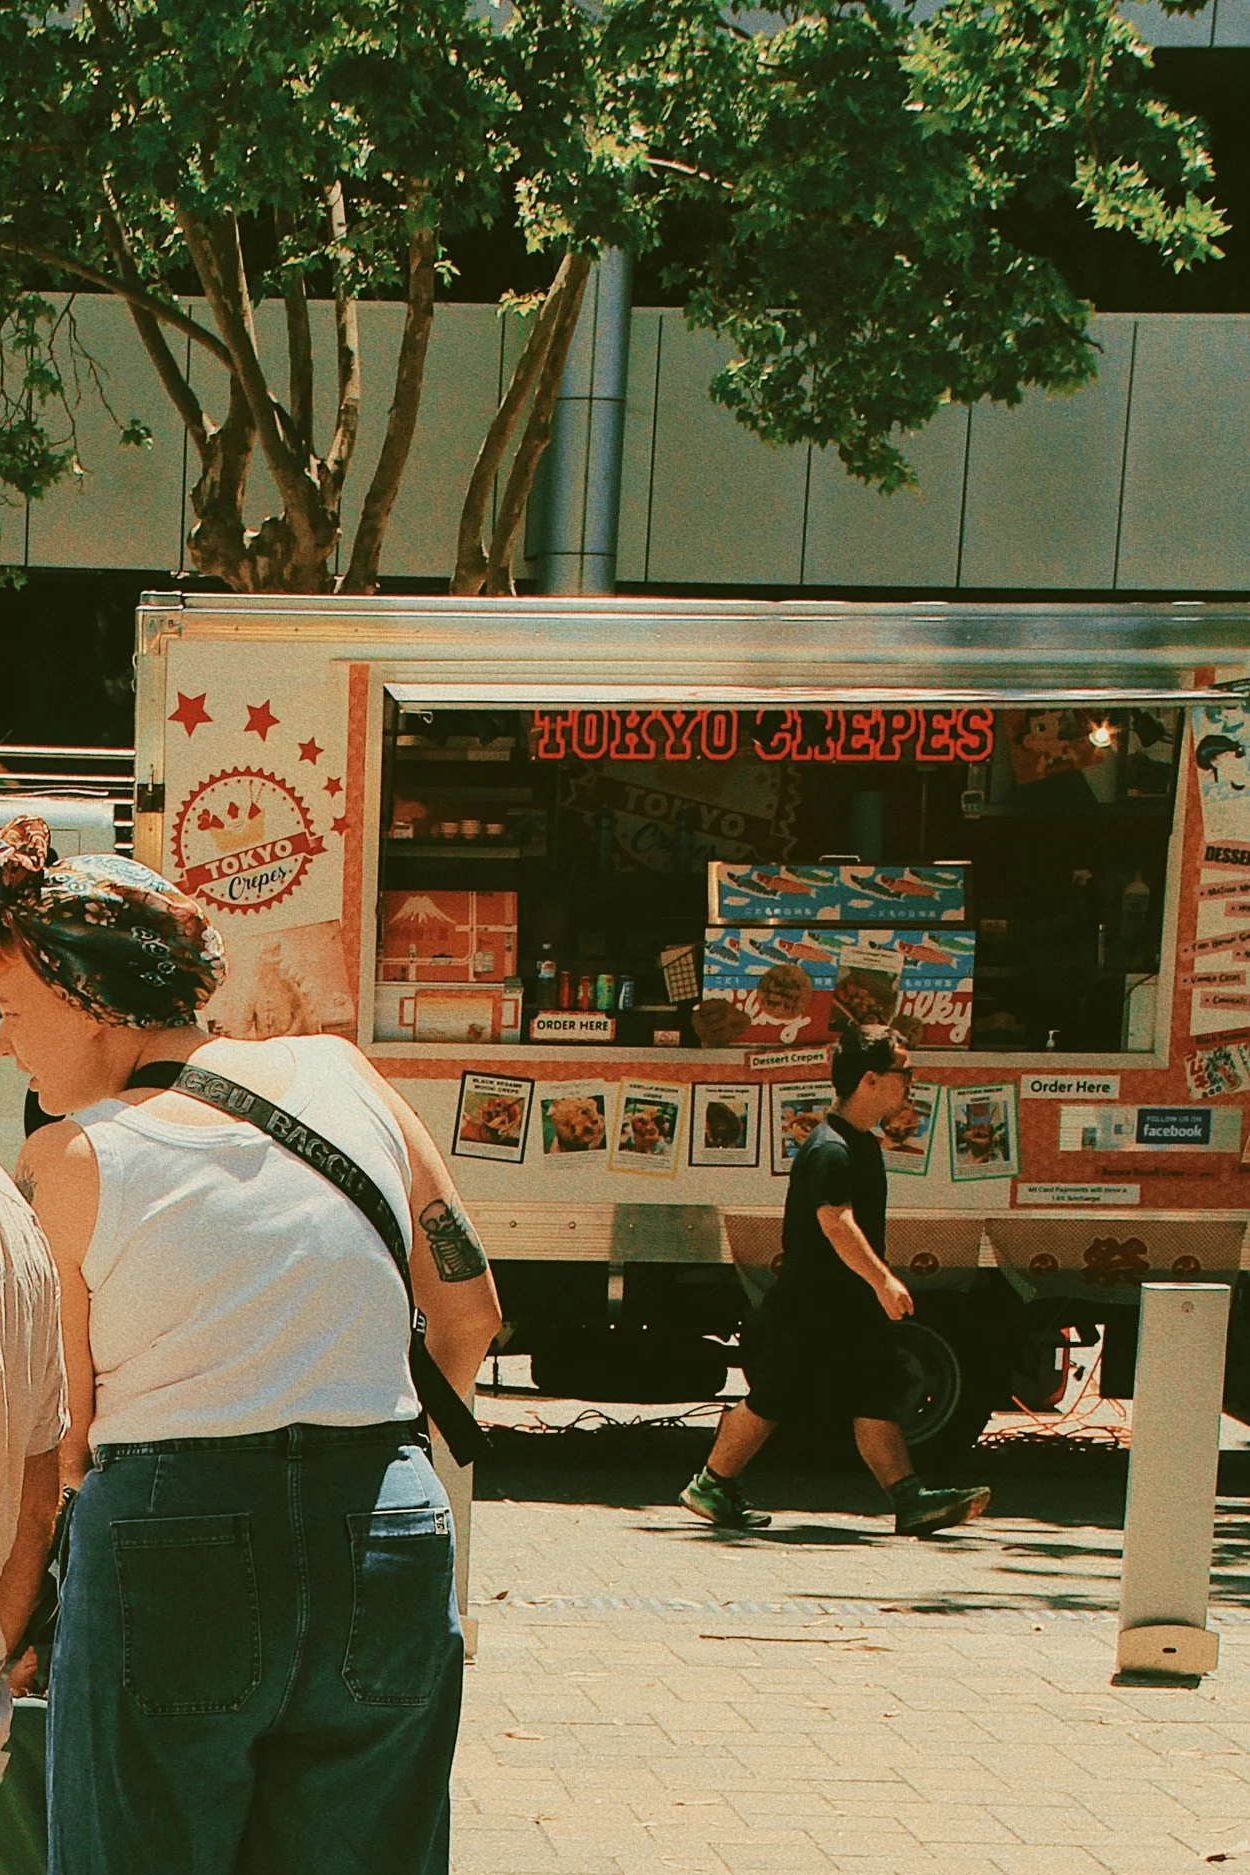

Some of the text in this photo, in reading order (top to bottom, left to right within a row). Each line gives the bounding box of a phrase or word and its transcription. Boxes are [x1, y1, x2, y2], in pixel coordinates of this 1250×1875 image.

[533, 709, 739, 760] TOKYO
[204, 839, 293, 879] TOKYO
[1204, 846, 1250, 866] DESSE
[228, 866, 288, 901] Crepes
[536, 1020, 610, 1031] ORDER HERE
[752, 1053, 825, 1066] Dessert Crepes
[1030, 1080, 1111, 1093] Order Here
[1143, 1123, 1203, 1137] facebook
